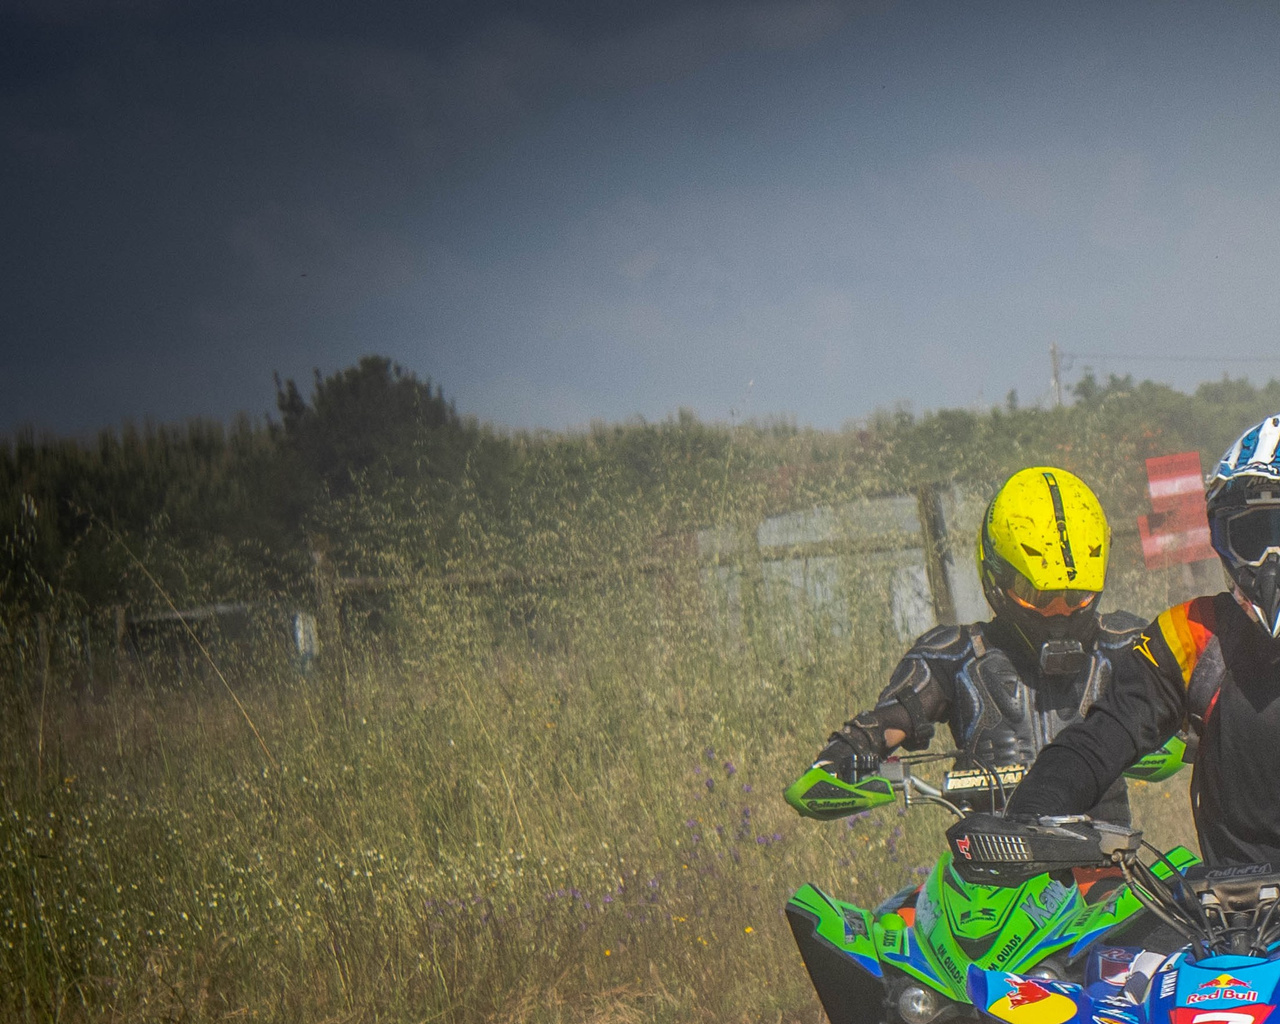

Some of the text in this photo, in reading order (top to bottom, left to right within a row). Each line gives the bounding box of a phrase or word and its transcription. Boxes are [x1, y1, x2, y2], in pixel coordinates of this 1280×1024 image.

[996, 933, 1021, 963] QUADS
[1187, 989, 1258, 1005] Red Bull
